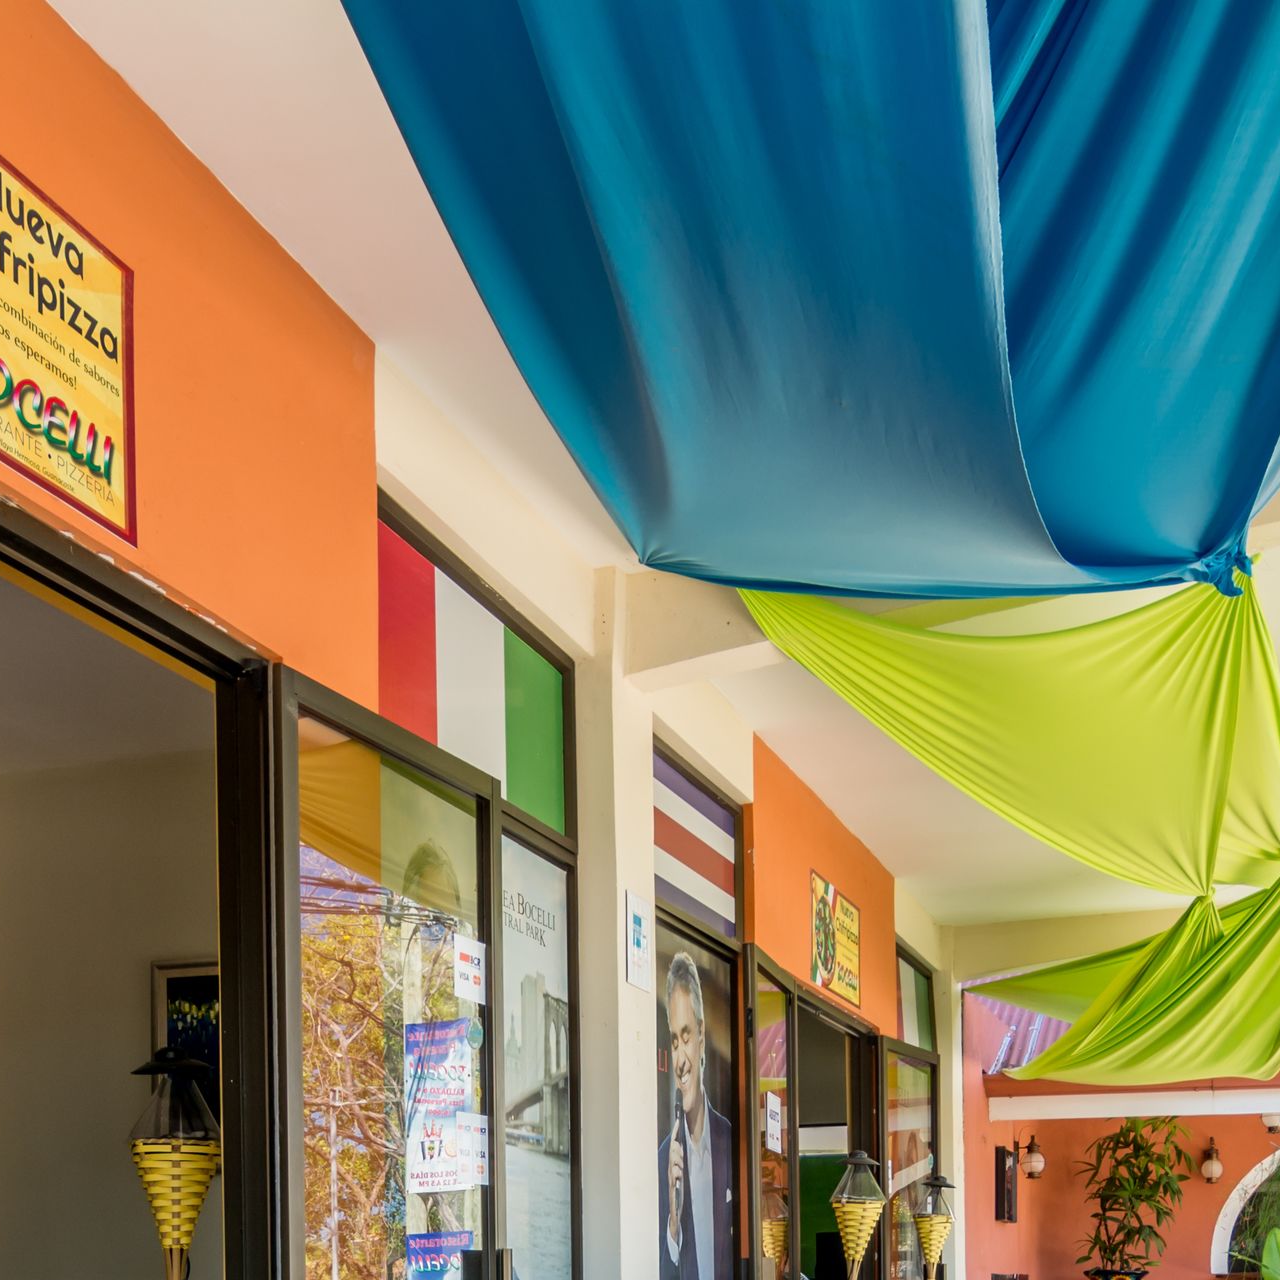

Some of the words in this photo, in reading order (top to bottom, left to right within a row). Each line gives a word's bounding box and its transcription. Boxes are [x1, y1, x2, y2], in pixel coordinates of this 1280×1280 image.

[14, 336, 77, 390] esperamos!
[69, 348, 81, 367] de
[83, 362, 120, 398] sabores
[56, 455, 116, 506] PIZZERIA
[525, 922, 546, 947] PARK
